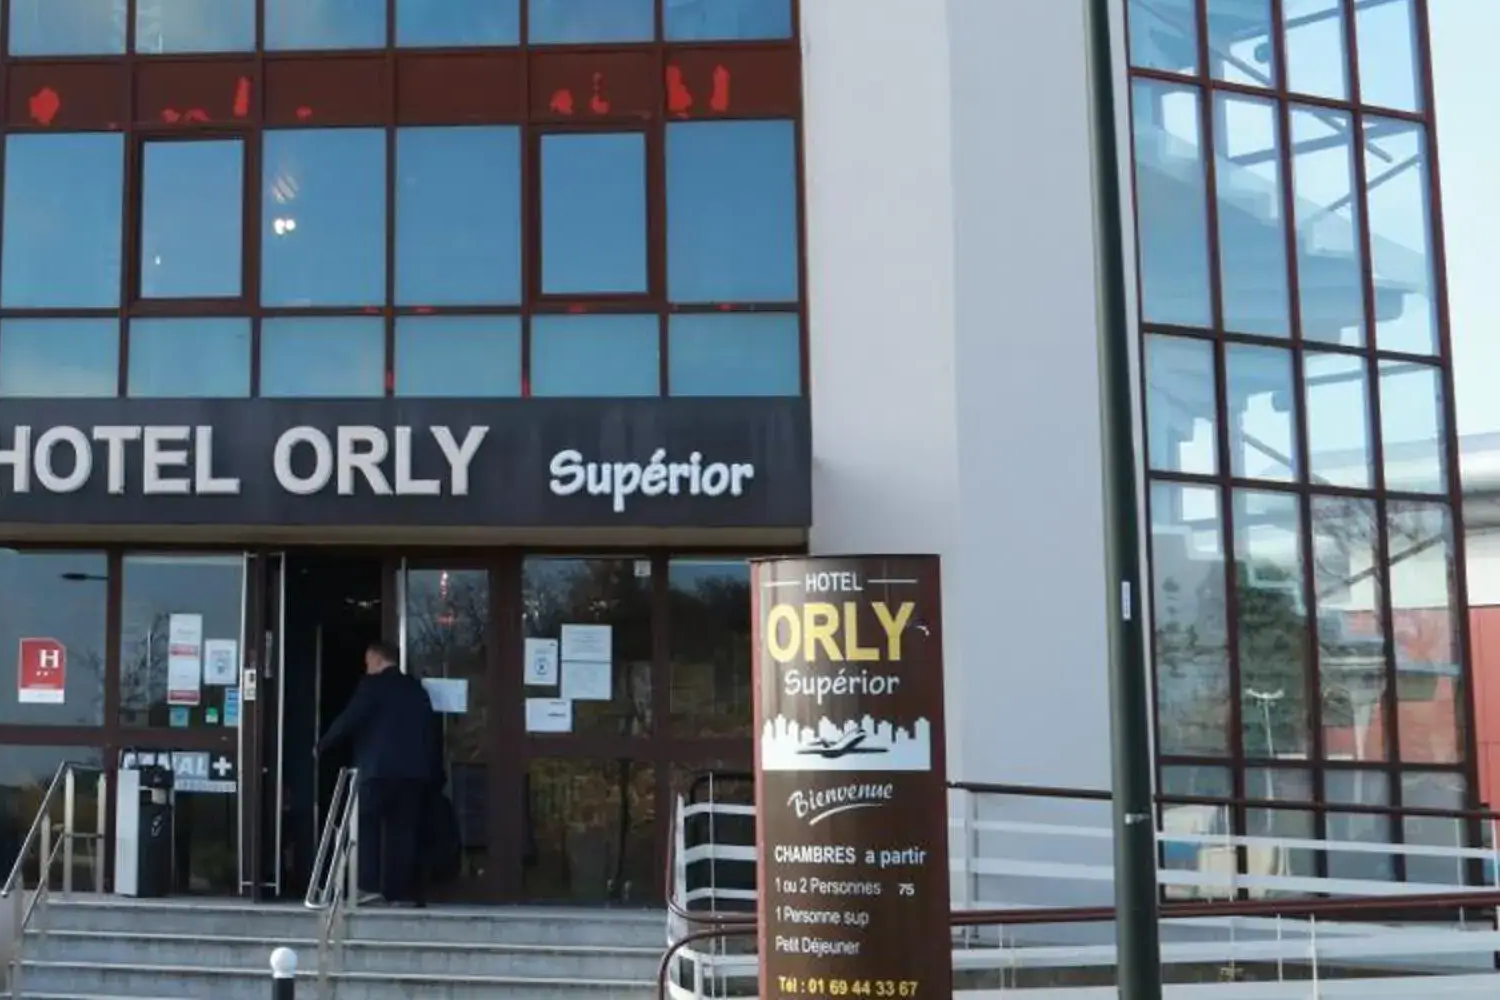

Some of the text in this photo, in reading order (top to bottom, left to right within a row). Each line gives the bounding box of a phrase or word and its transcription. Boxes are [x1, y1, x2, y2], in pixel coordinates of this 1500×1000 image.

[273, 425, 490, 495] ORLY
[550, 448, 754, 512] Supérior
[805, 572, 864, 592] HOTEL
[767, 601, 915, 663] ORLY
[40, 649, 59, 668] H
[784, 668, 899, 705] Supérior
[786, 783, 893, 818] Bienvenue
[774, 845, 857, 864] CHAMBRES
[880, 846, 927, 868] partir
[775, 877, 781, 892] 1
[783, 880, 797, 893] ou
[800, 878, 807, 893] 2
[810, 877, 881, 895] Personnes
[775, 905, 870, 928] 1 Personne sup
[775, 935, 860, 957] Petit Déjeuner
[808, 978, 825, 994] 01
[829, 979, 848, 995] 69
[851, 980, 871, 995] 44
[875, 981, 895, 996] 33
